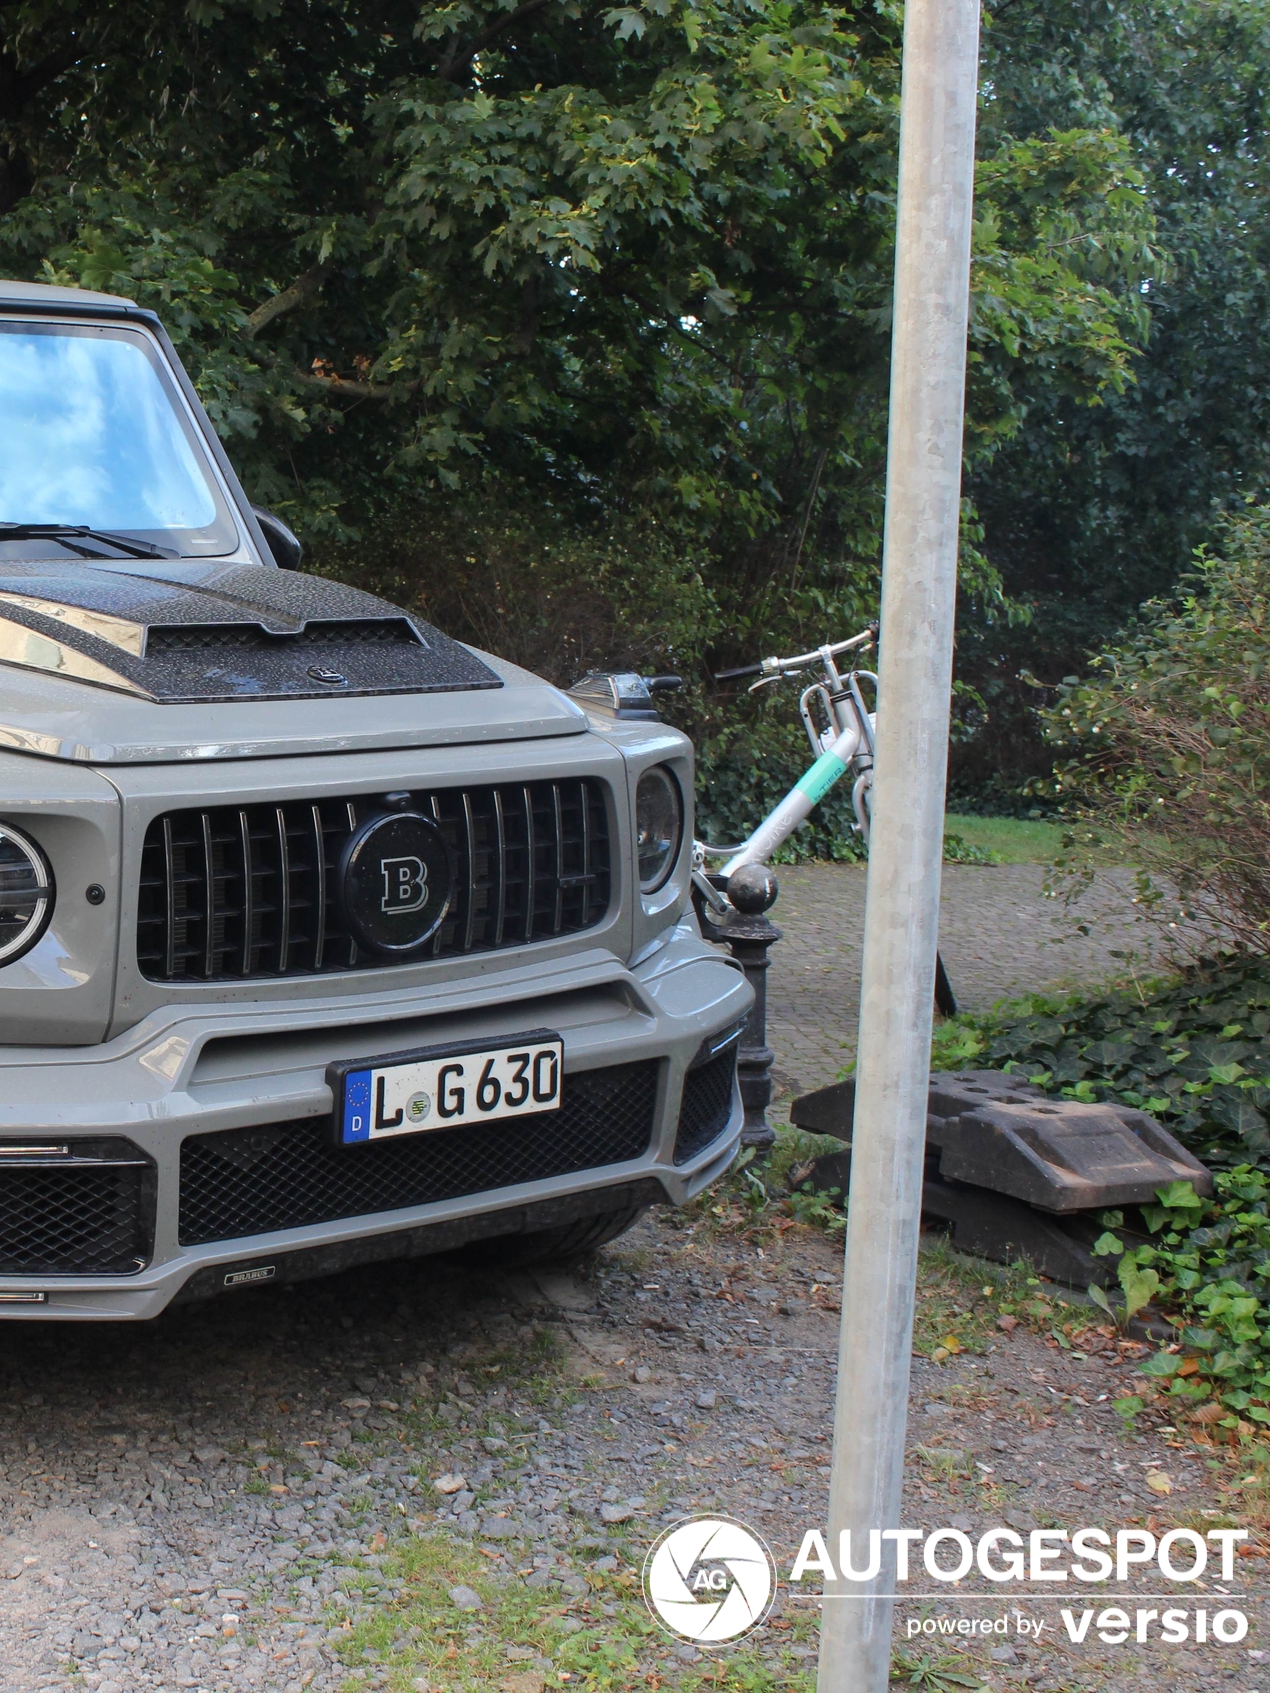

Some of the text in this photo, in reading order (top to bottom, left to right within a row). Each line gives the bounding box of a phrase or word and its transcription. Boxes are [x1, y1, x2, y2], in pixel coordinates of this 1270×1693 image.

[820, 767, 842, 791] TIER
[380, 856, 429, 915] B
[375, 1050, 558, 1130] L G 630
[351, 1115, 363, 1132] D
[232, 1269, 269, 1282] BRABUS
